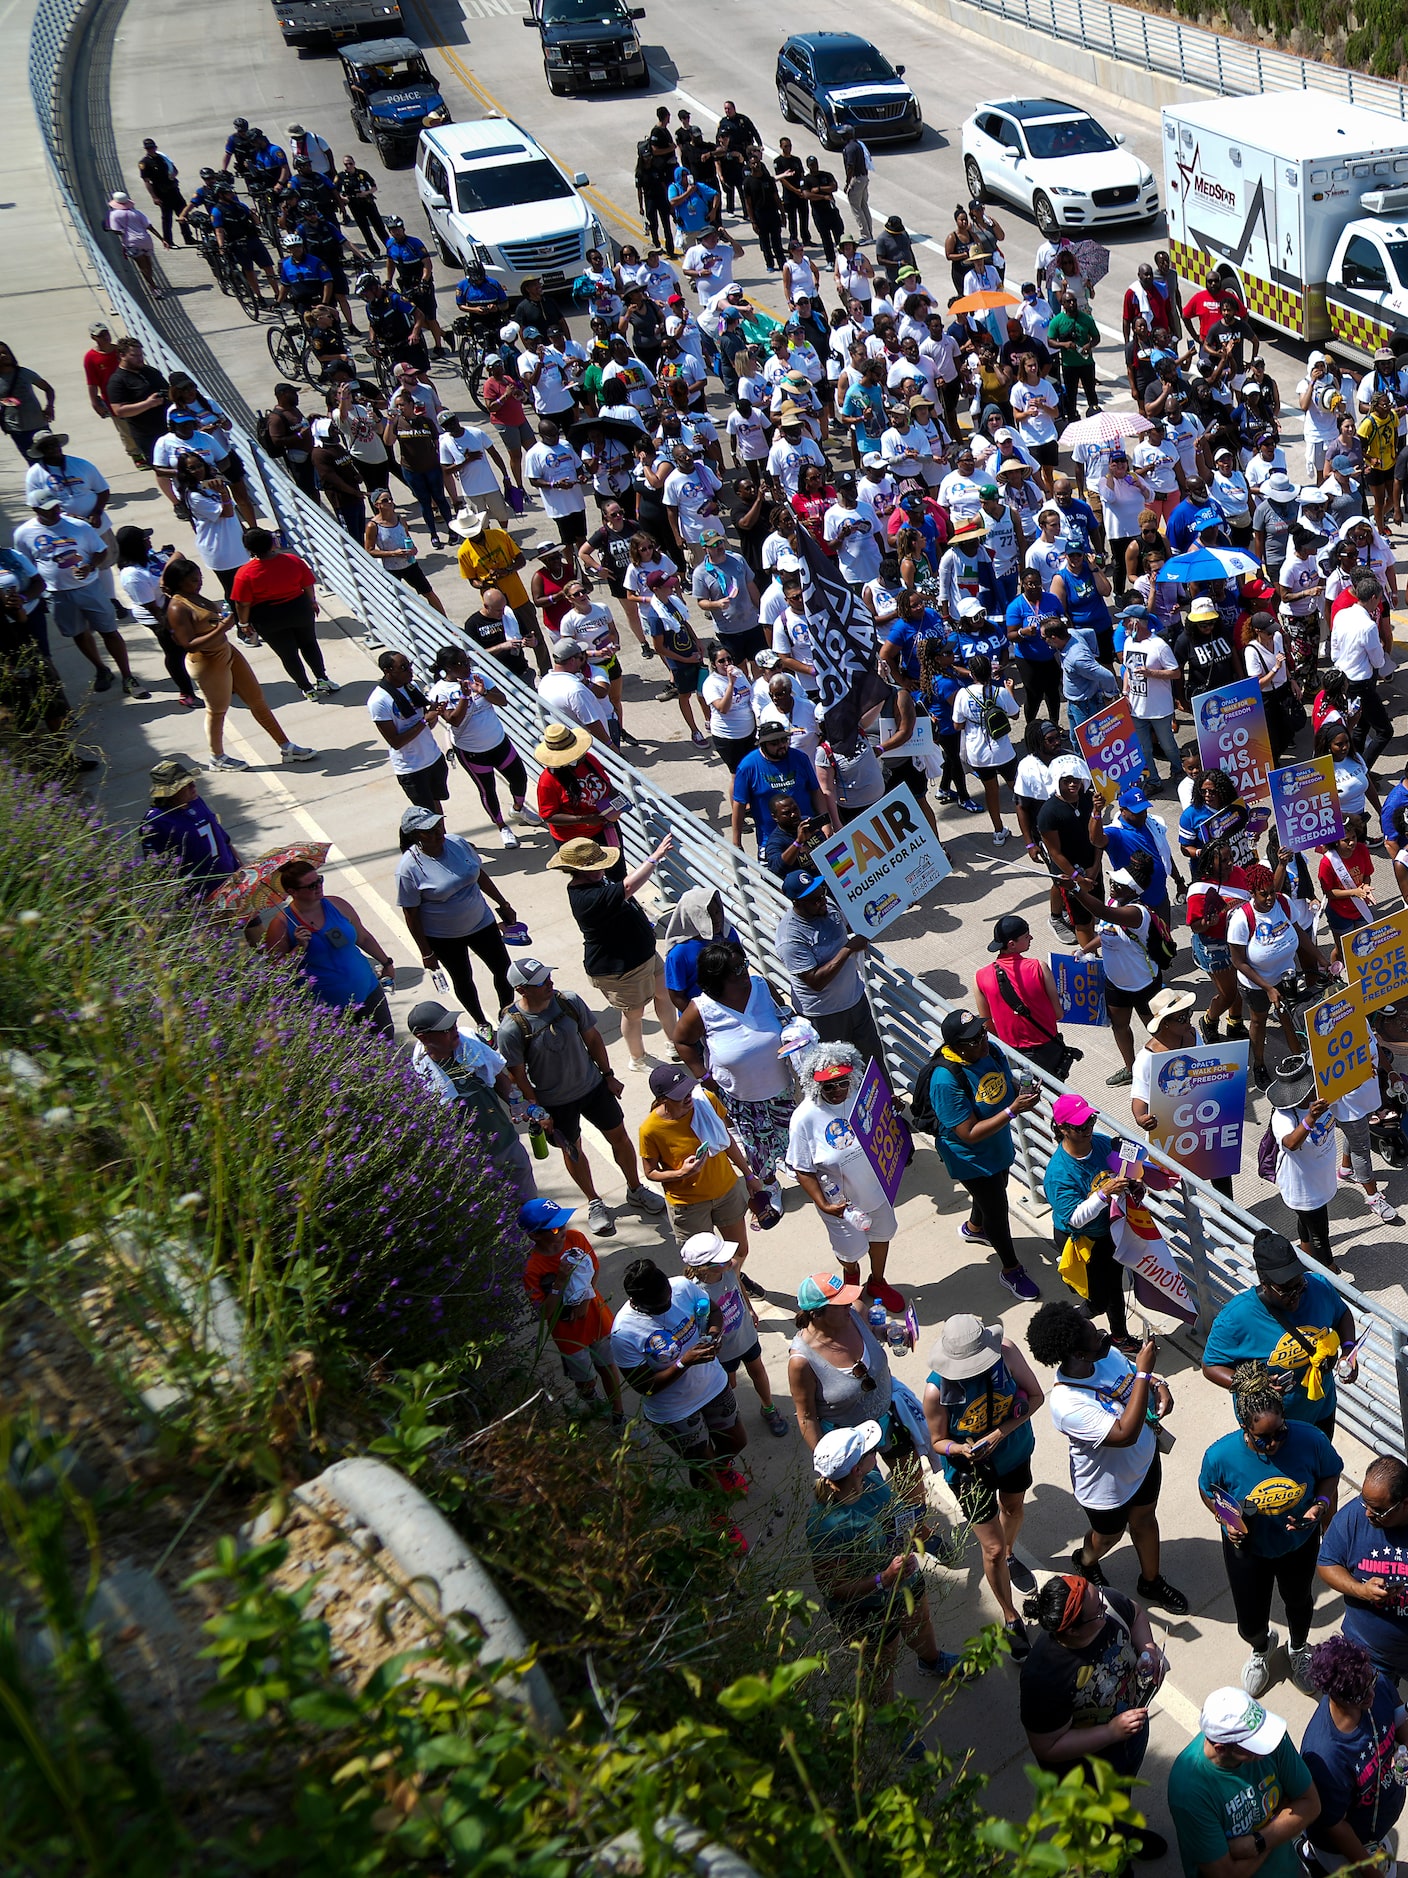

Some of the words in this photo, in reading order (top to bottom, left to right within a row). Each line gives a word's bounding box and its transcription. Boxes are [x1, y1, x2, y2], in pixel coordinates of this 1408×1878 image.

[386, 91, 422, 104] POLICE
[1392, 300, 1402, 309] 44
[1000, 536, 1013, 548] 77
[1194, 637, 1232, 665] BETO
[1221, 696, 1238, 707] OPAL'S
[1223, 703, 1238, 712] WALK
[1238, 700, 1248, 708] FOR
[1224, 706, 1251, 720] FREEDOM
[1100, 738, 1126, 764] GO
[1218, 727, 1249, 752] GO
[1095, 749, 1142, 788] VOTE
[1219, 750, 1256, 774] MS.
[1231, 762, 1270, 793] PAL!
[1299, 776, 1323, 787] FREEDOM
[1282, 792, 1332, 818] VOTE
[1285, 807, 1336, 836] FOR
[824, 800, 920, 879] FAIR
[1288, 826, 1336, 847] FREEDOM
[1232, 840, 1253, 864] OR
[847, 864, 891, 903] HOUSING
[889, 848, 910, 869] FOR
[910, 835, 927, 853] ALL
[1372, 926, 1388, 936] OPAL'S
[1374, 931, 1400, 946] FREEDOM
[1386, 928, 1397, 936] FOR
[1357, 946, 1406, 977] VOTE
[1074, 974, 1086, 1006] GO
[1360, 960, 1408, 995] FOR
[1087, 962, 1098, 1022] VOTE
[1330, 1000, 1344, 1013] OPAL'S
[1332, 1008, 1354, 1024] FREEDOM
[1328, 1030, 1354, 1058] GO
[1190, 1058, 1214, 1070] OPAL'S
[1192, 1067, 1212, 1076] WALK
[1214, 1064, 1228, 1073] FOR
[1318, 1044, 1368, 1087] VOTE
[980, 1078, 1005, 1099] Dickies
[1192, 1073, 1230, 1084] FREEDOM
[1173, 1100, 1220, 1128] GO
[871, 1102, 892, 1157] VOTE
[1152, 1124, 1240, 1156] VOTE
[878, 1116, 901, 1177] FOR
[886, 1136, 905, 1187] FREEDOM
[1252, 1490, 1301, 1506] Dickies
[1225, 1786, 1256, 1816] HEAD
[1232, 1809, 1244, 1824] for
[1244, 1799, 1257, 1815] the
[1232, 1806, 1261, 1835] CURE
